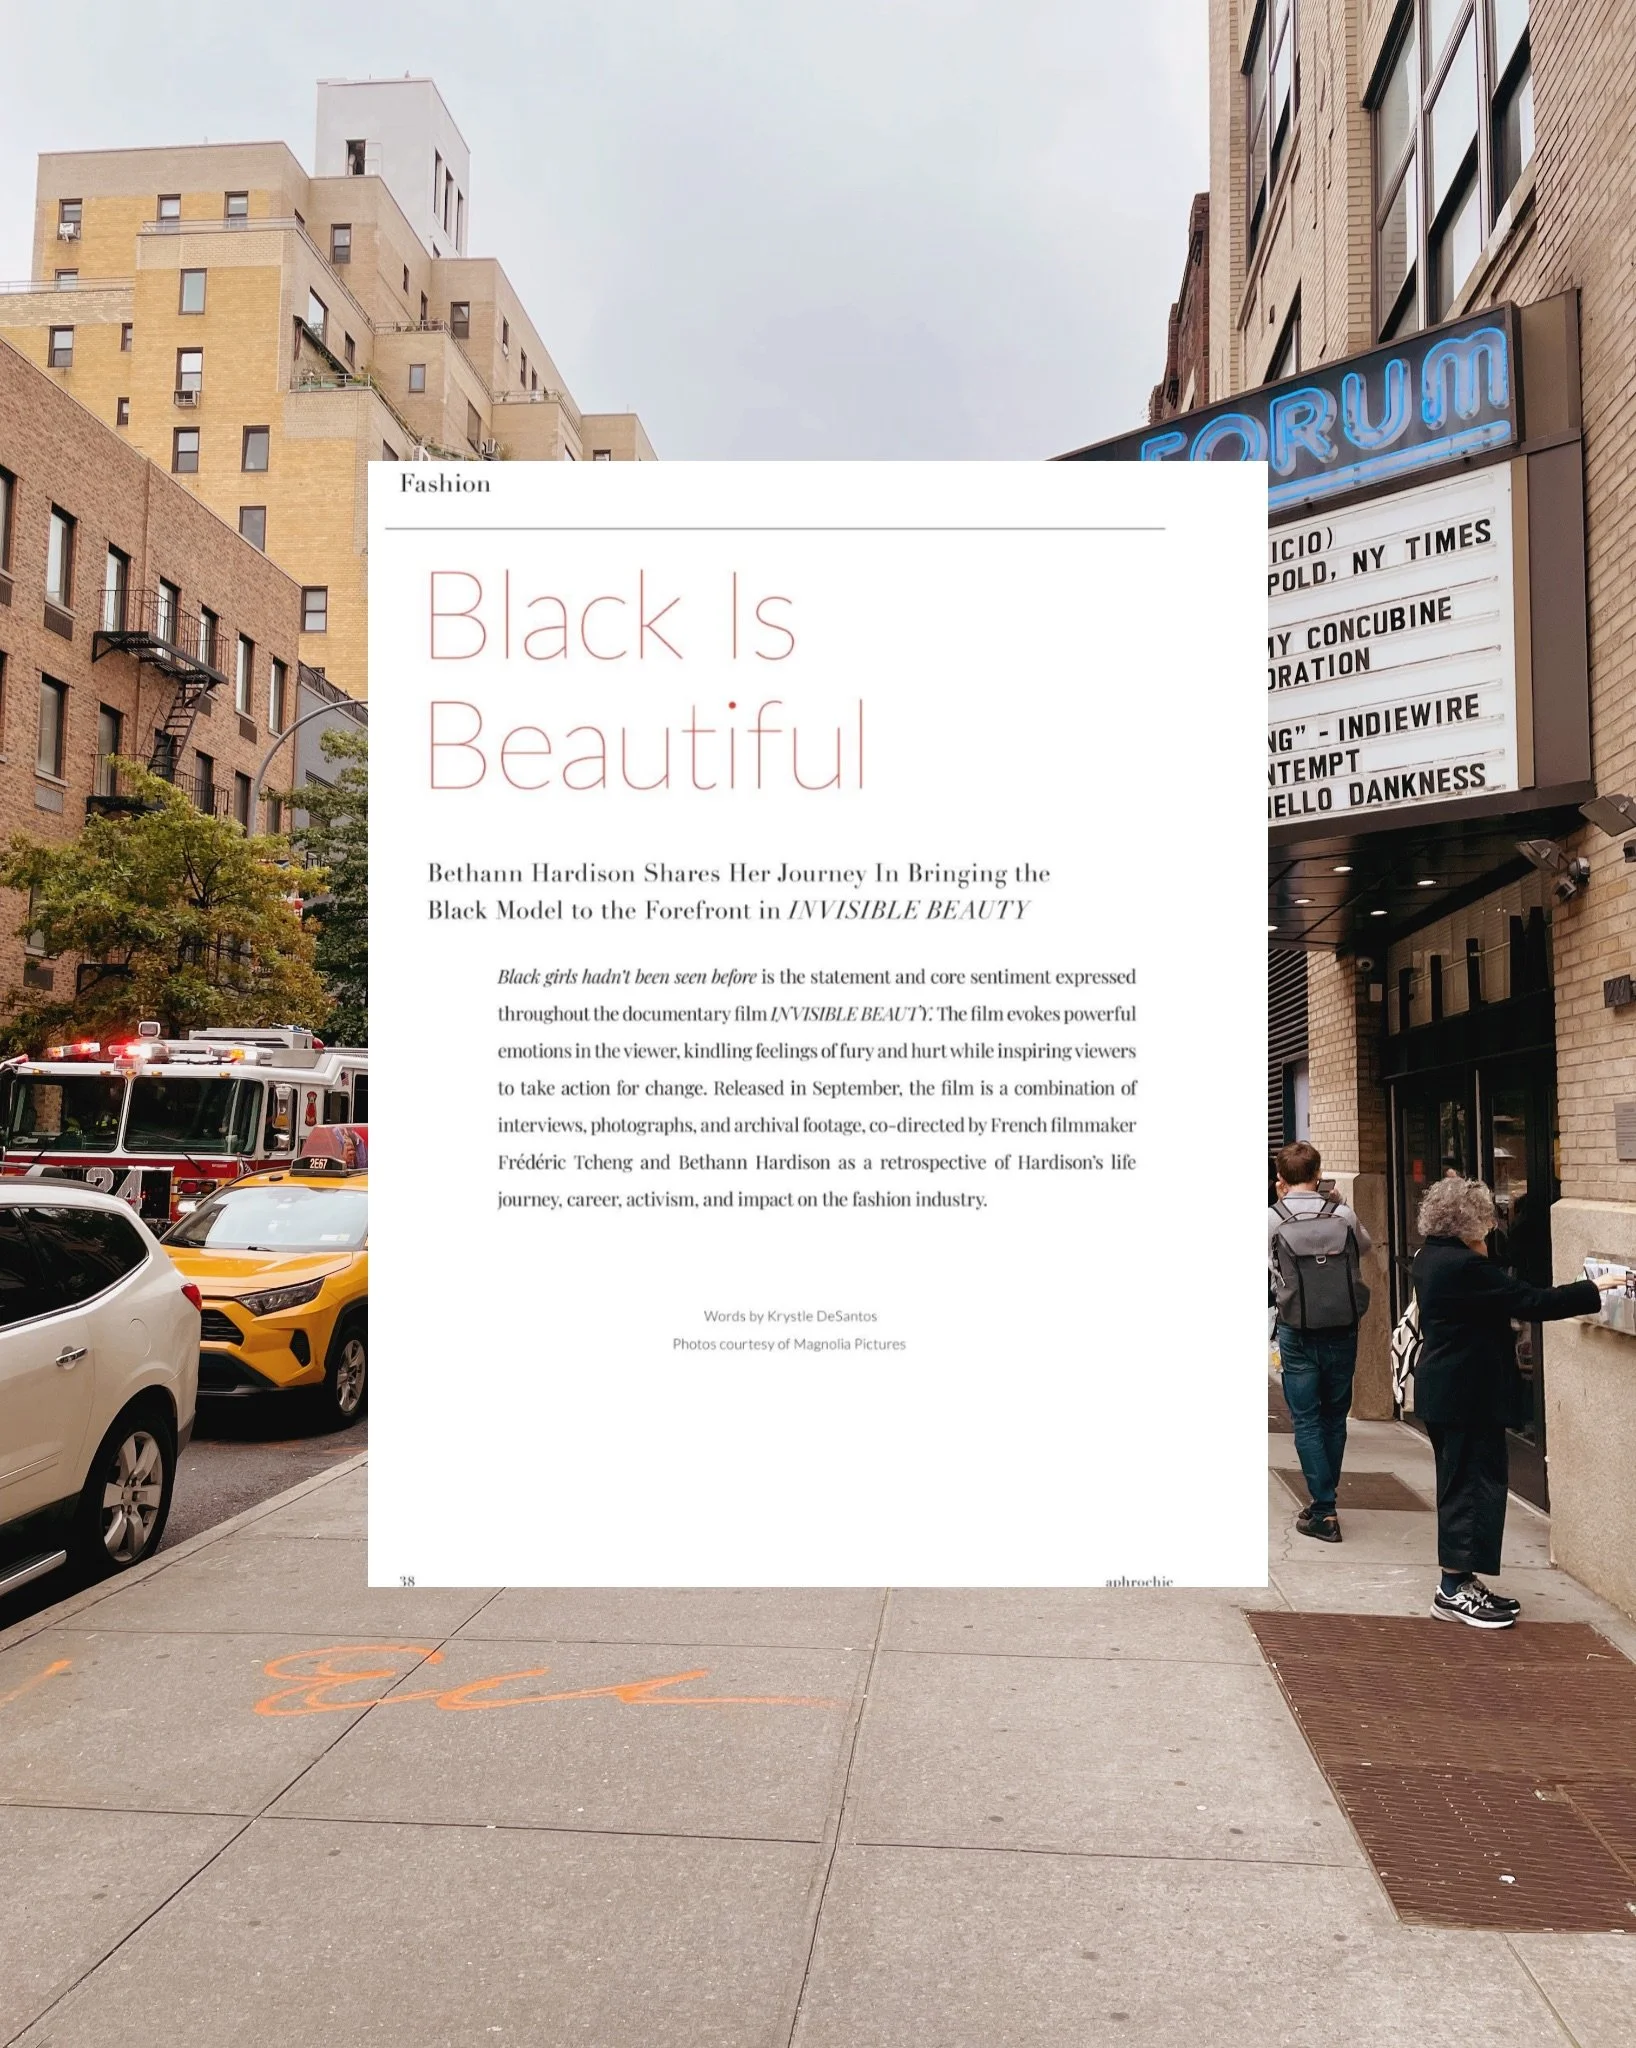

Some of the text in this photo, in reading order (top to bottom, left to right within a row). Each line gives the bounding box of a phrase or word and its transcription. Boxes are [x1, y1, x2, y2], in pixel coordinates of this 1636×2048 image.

[1268, 518, 1491, 595] POLD, NY TIMES
[1271, 527, 1333, 563] ICIO)
[1307, 596, 1451, 650] CONCUBINE
[1338, 693, 1479, 741] INDIEWIRE
[1349, 763, 1486, 806] DANKNESS
[309, 1158, 328, 1169] 2E67
